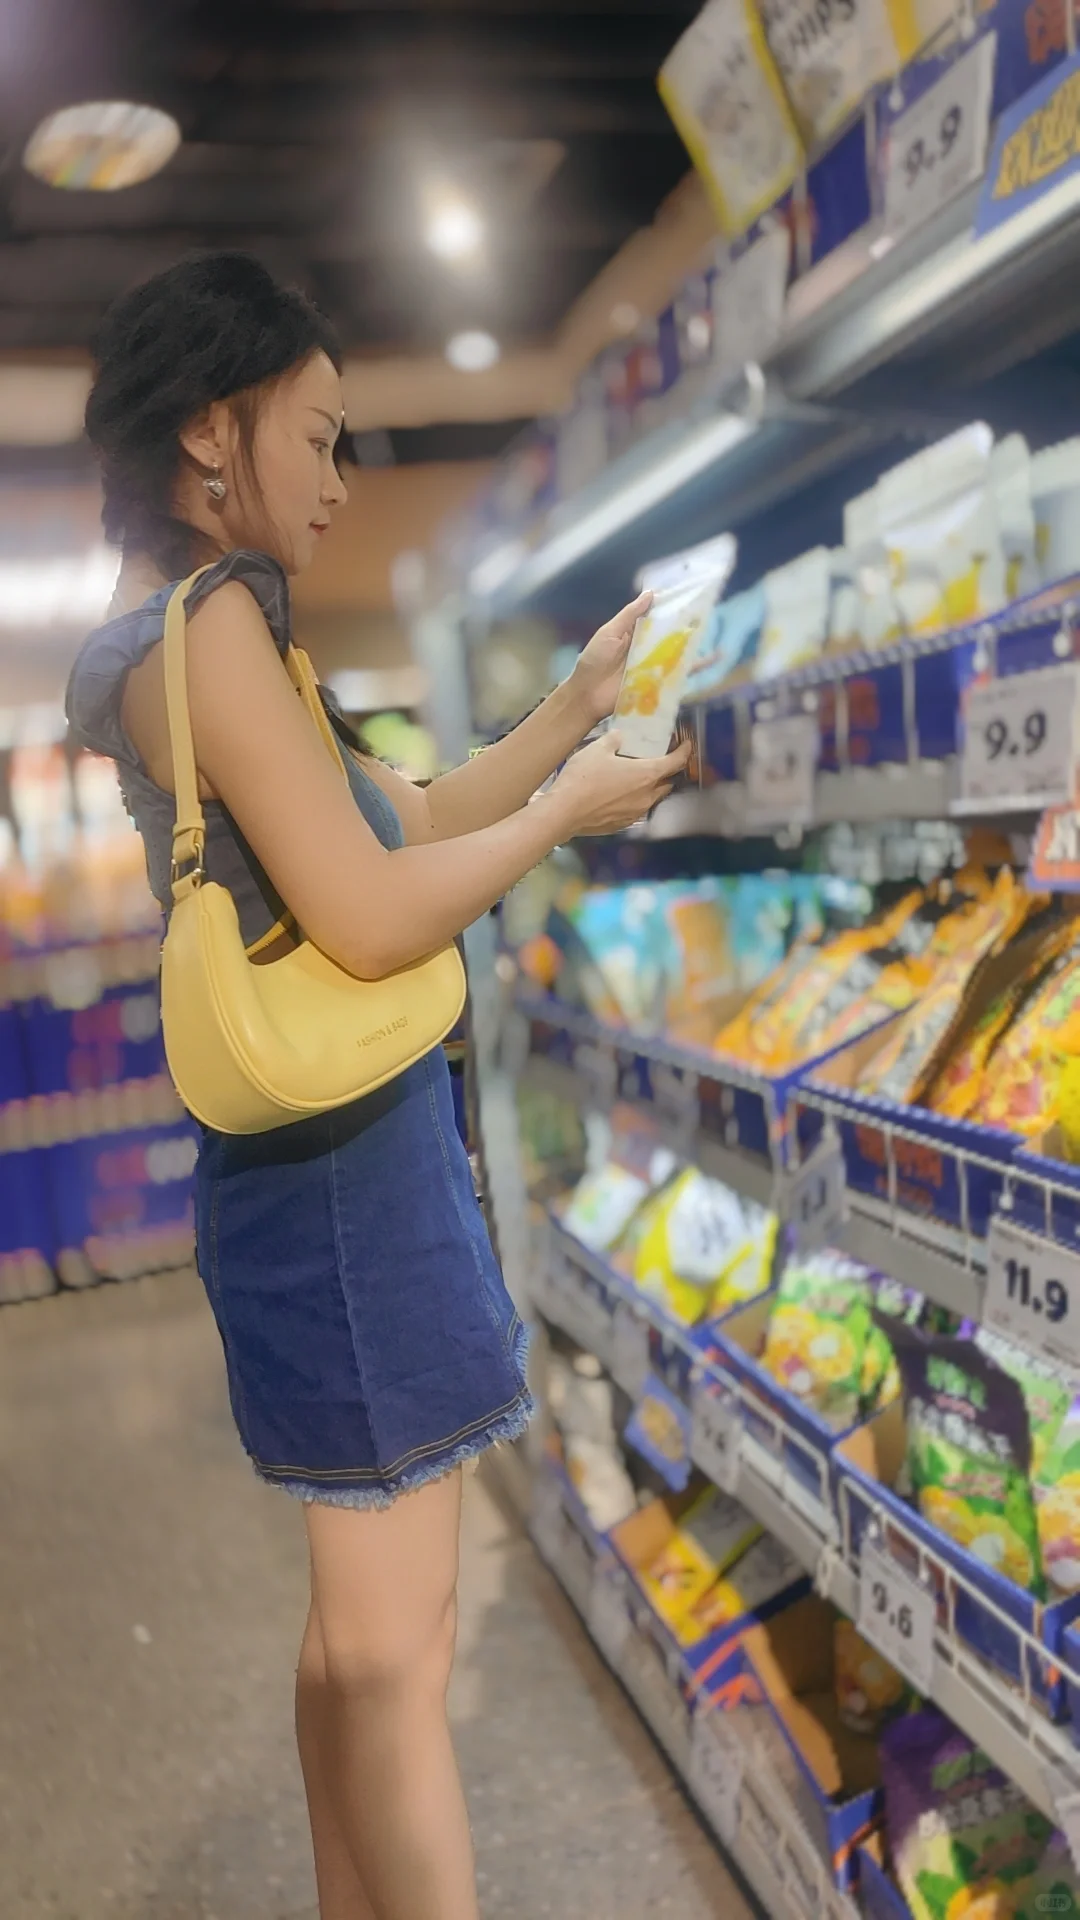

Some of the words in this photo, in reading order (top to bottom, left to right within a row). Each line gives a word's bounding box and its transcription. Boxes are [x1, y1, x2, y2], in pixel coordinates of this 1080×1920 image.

[904, 103, 963, 191] 9.9
[984, 710, 1047, 761] 9.9
[1005, 1258, 1069, 1322] 11.9
